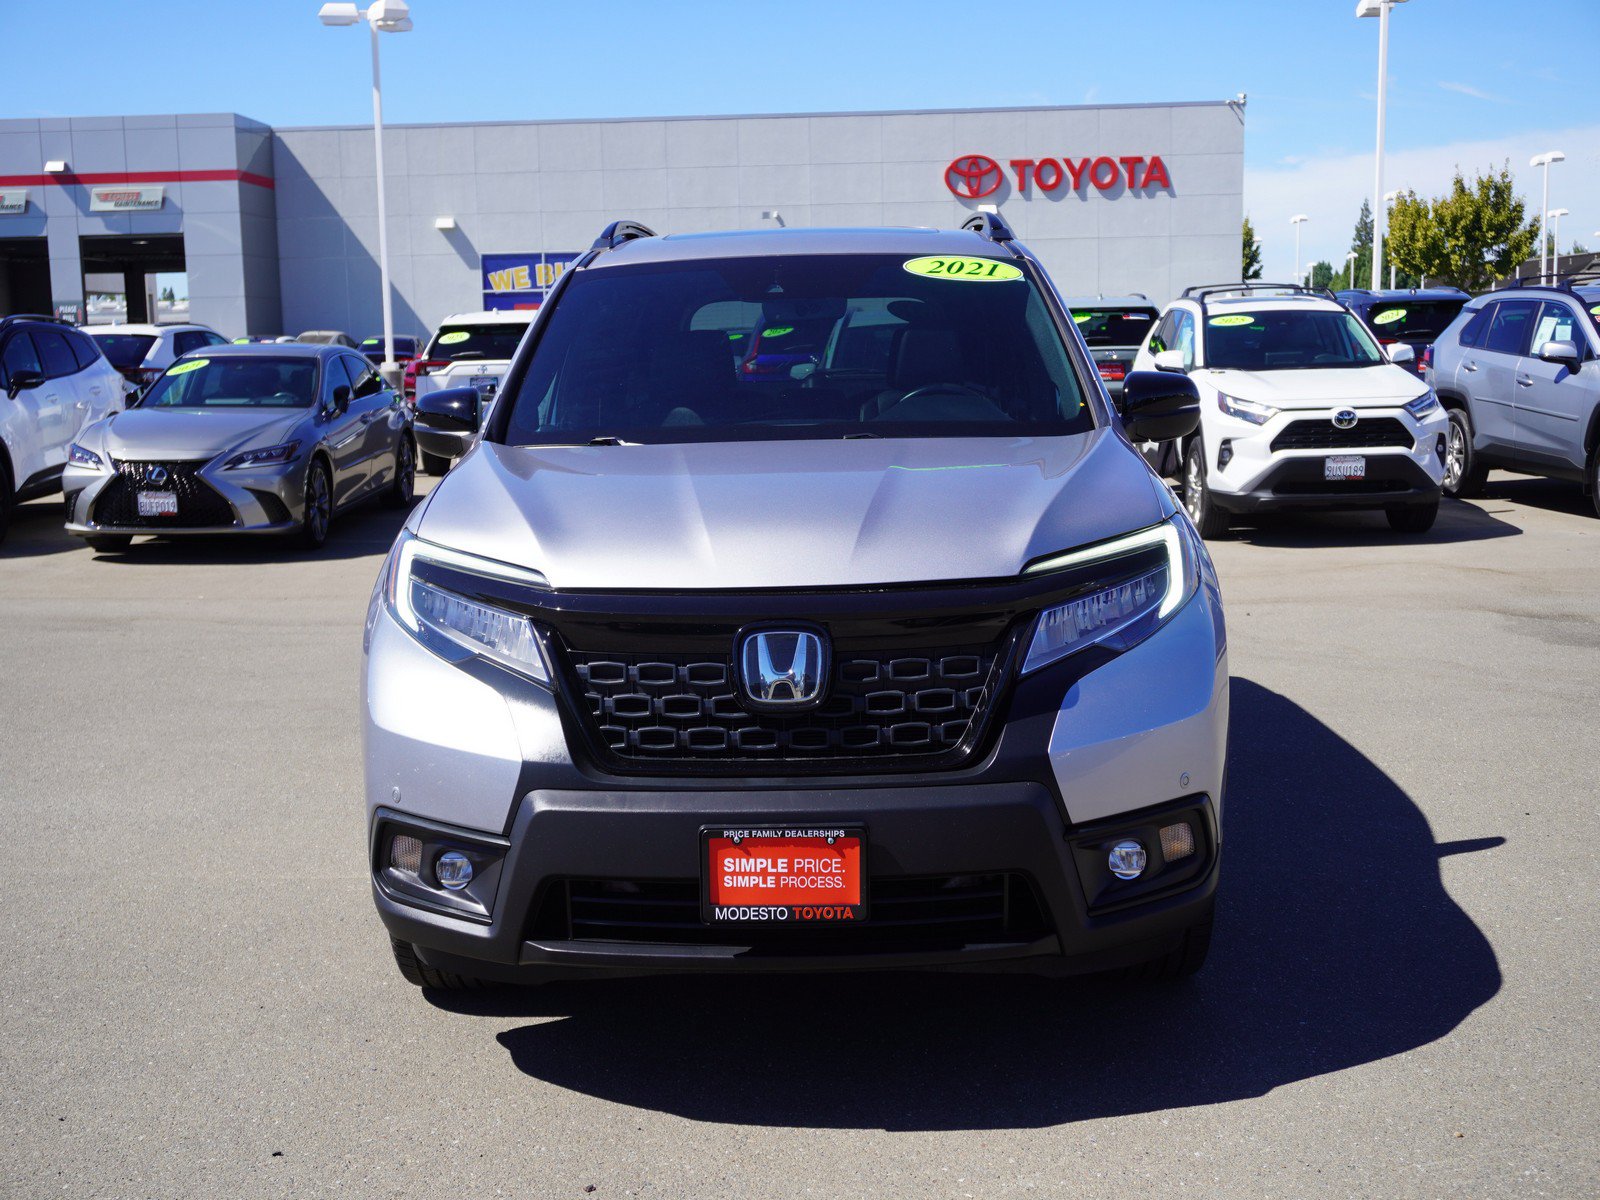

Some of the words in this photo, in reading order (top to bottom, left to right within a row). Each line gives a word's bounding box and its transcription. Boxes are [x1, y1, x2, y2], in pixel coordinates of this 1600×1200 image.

[1010, 156, 1170, 192] TOYOTA
[926, 260, 1000, 276] 2021
[487, 265, 531, 294] WE
[723, 830, 750, 838] PRICE
[752, 830, 782, 838] FAMILY
[785, 830, 845, 838] DEALERSHIPS
[723, 858, 788, 873] SIMPLE
[794, 858, 846, 873] PRICE.
[723, 876, 776, 888] SIMPLE
[780, 876, 846, 888] PROCESS.
[715, 907, 788, 920] MODESTO
[792, 906, 854, 920] TOYOTA
